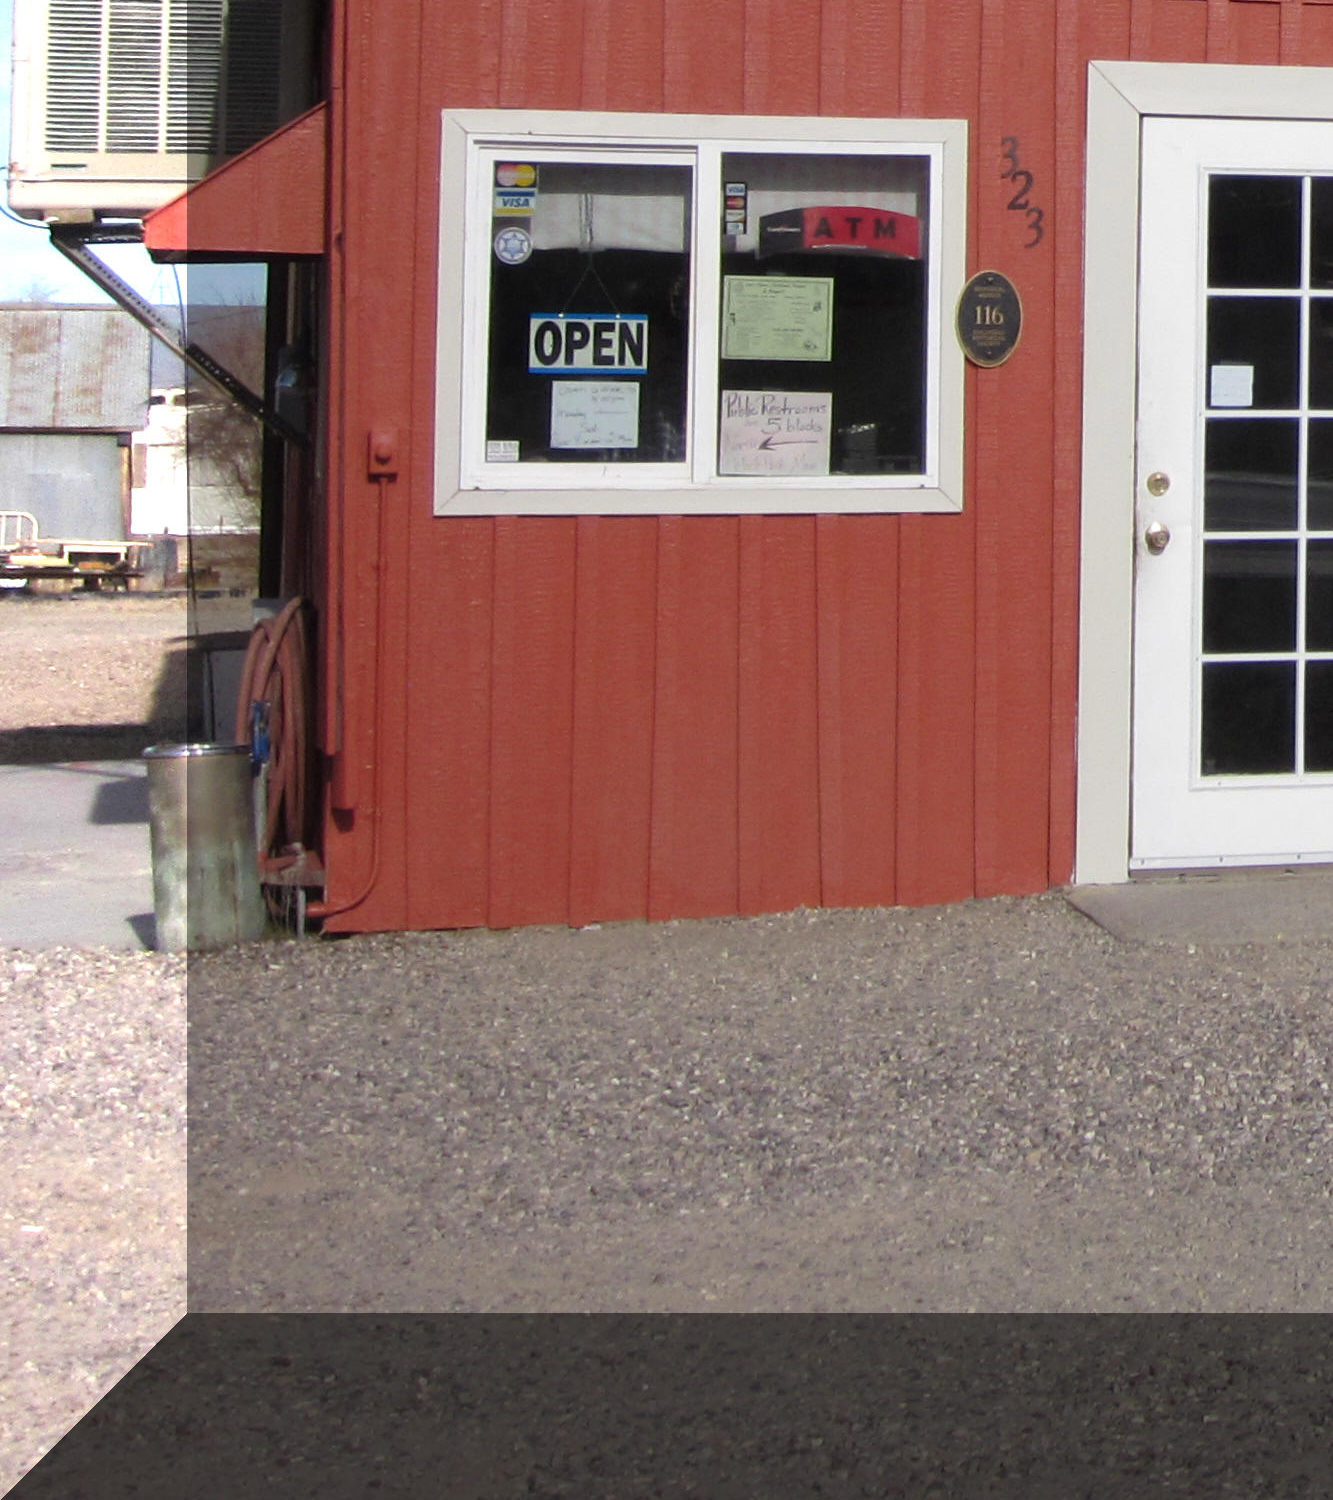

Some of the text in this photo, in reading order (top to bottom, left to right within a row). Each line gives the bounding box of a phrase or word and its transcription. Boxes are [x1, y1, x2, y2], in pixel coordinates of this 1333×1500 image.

[502, 197, 530, 207] VISA
[1000, 136, 1044, 249] 323
[814, 216, 897, 239] ATM
[976, 304, 1004, 325] 116
[534, 320, 644, 367] OPEN
[727, 392, 827, 418] Public Restrooms
[761, 417, 781, 435] 5
